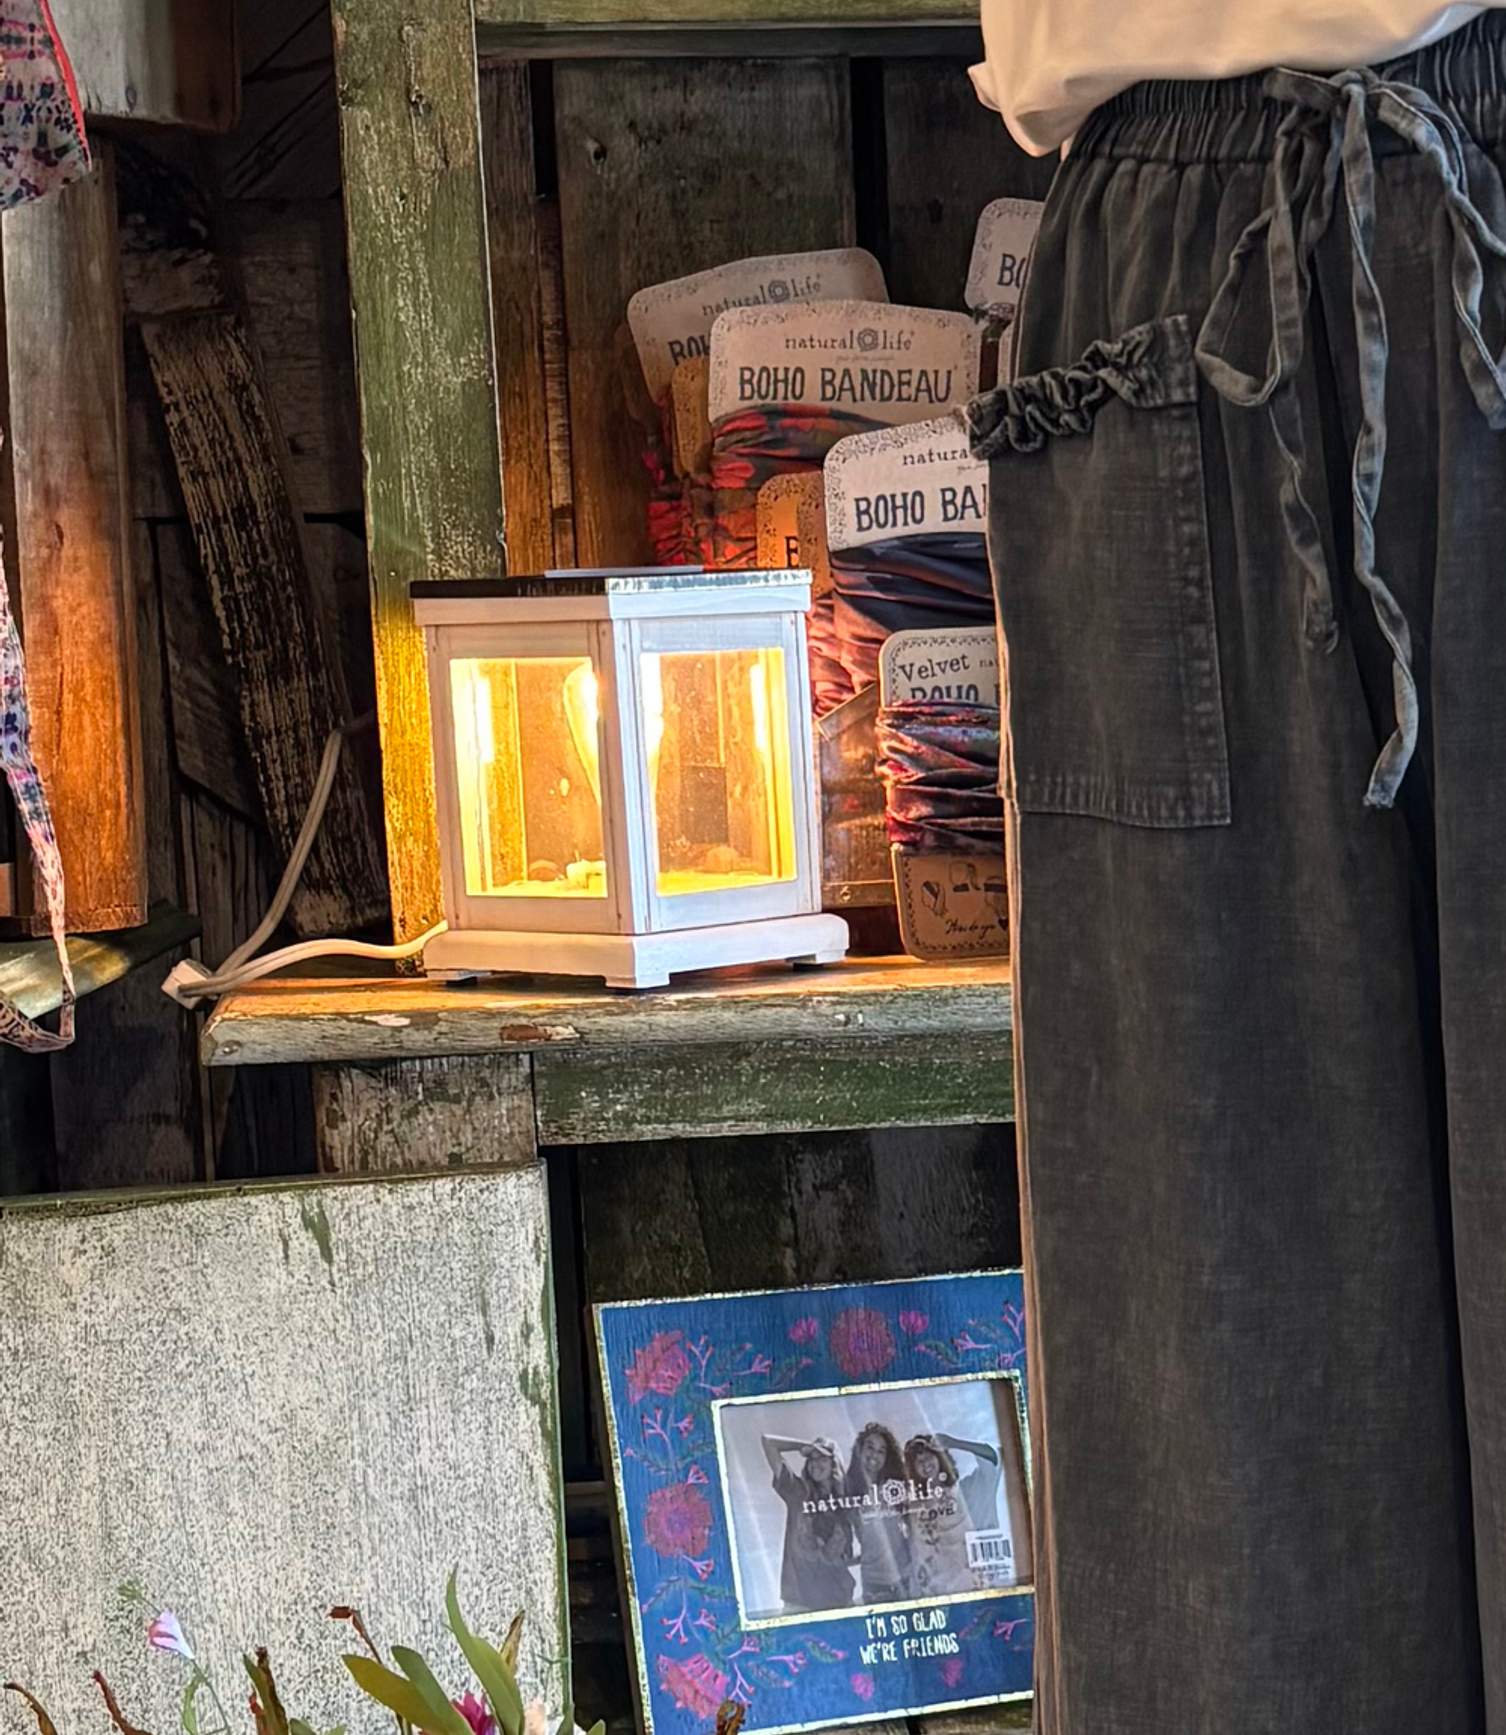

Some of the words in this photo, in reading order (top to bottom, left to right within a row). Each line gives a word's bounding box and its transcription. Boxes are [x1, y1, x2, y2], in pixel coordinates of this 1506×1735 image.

[702, 284, 767, 318] natural
[793, 279, 822, 298] life
[667, 334, 711, 367] BO
[785, 330, 854, 350] natural
[882, 330, 912, 351] life
[739, 366, 806, 402] BOHO
[819, 367, 953, 404] BANDEAU
[903, 447, 969, 467] natura
[854, 489, 925, 533] BOHO
[899, 654, 971, 683] Velvet
[802, 1483, 879, 1514] natural
[908, 1478, 944, 1502] life
[865, 1616, 887, 1640] I'M
[891, 1615, 908, 1636] SO
[912, 1608, 947, 1632] GLAD
[859, 1641, 898, 1665] WE'RE
[902, 1632, 960, 1659] FRIENDS
